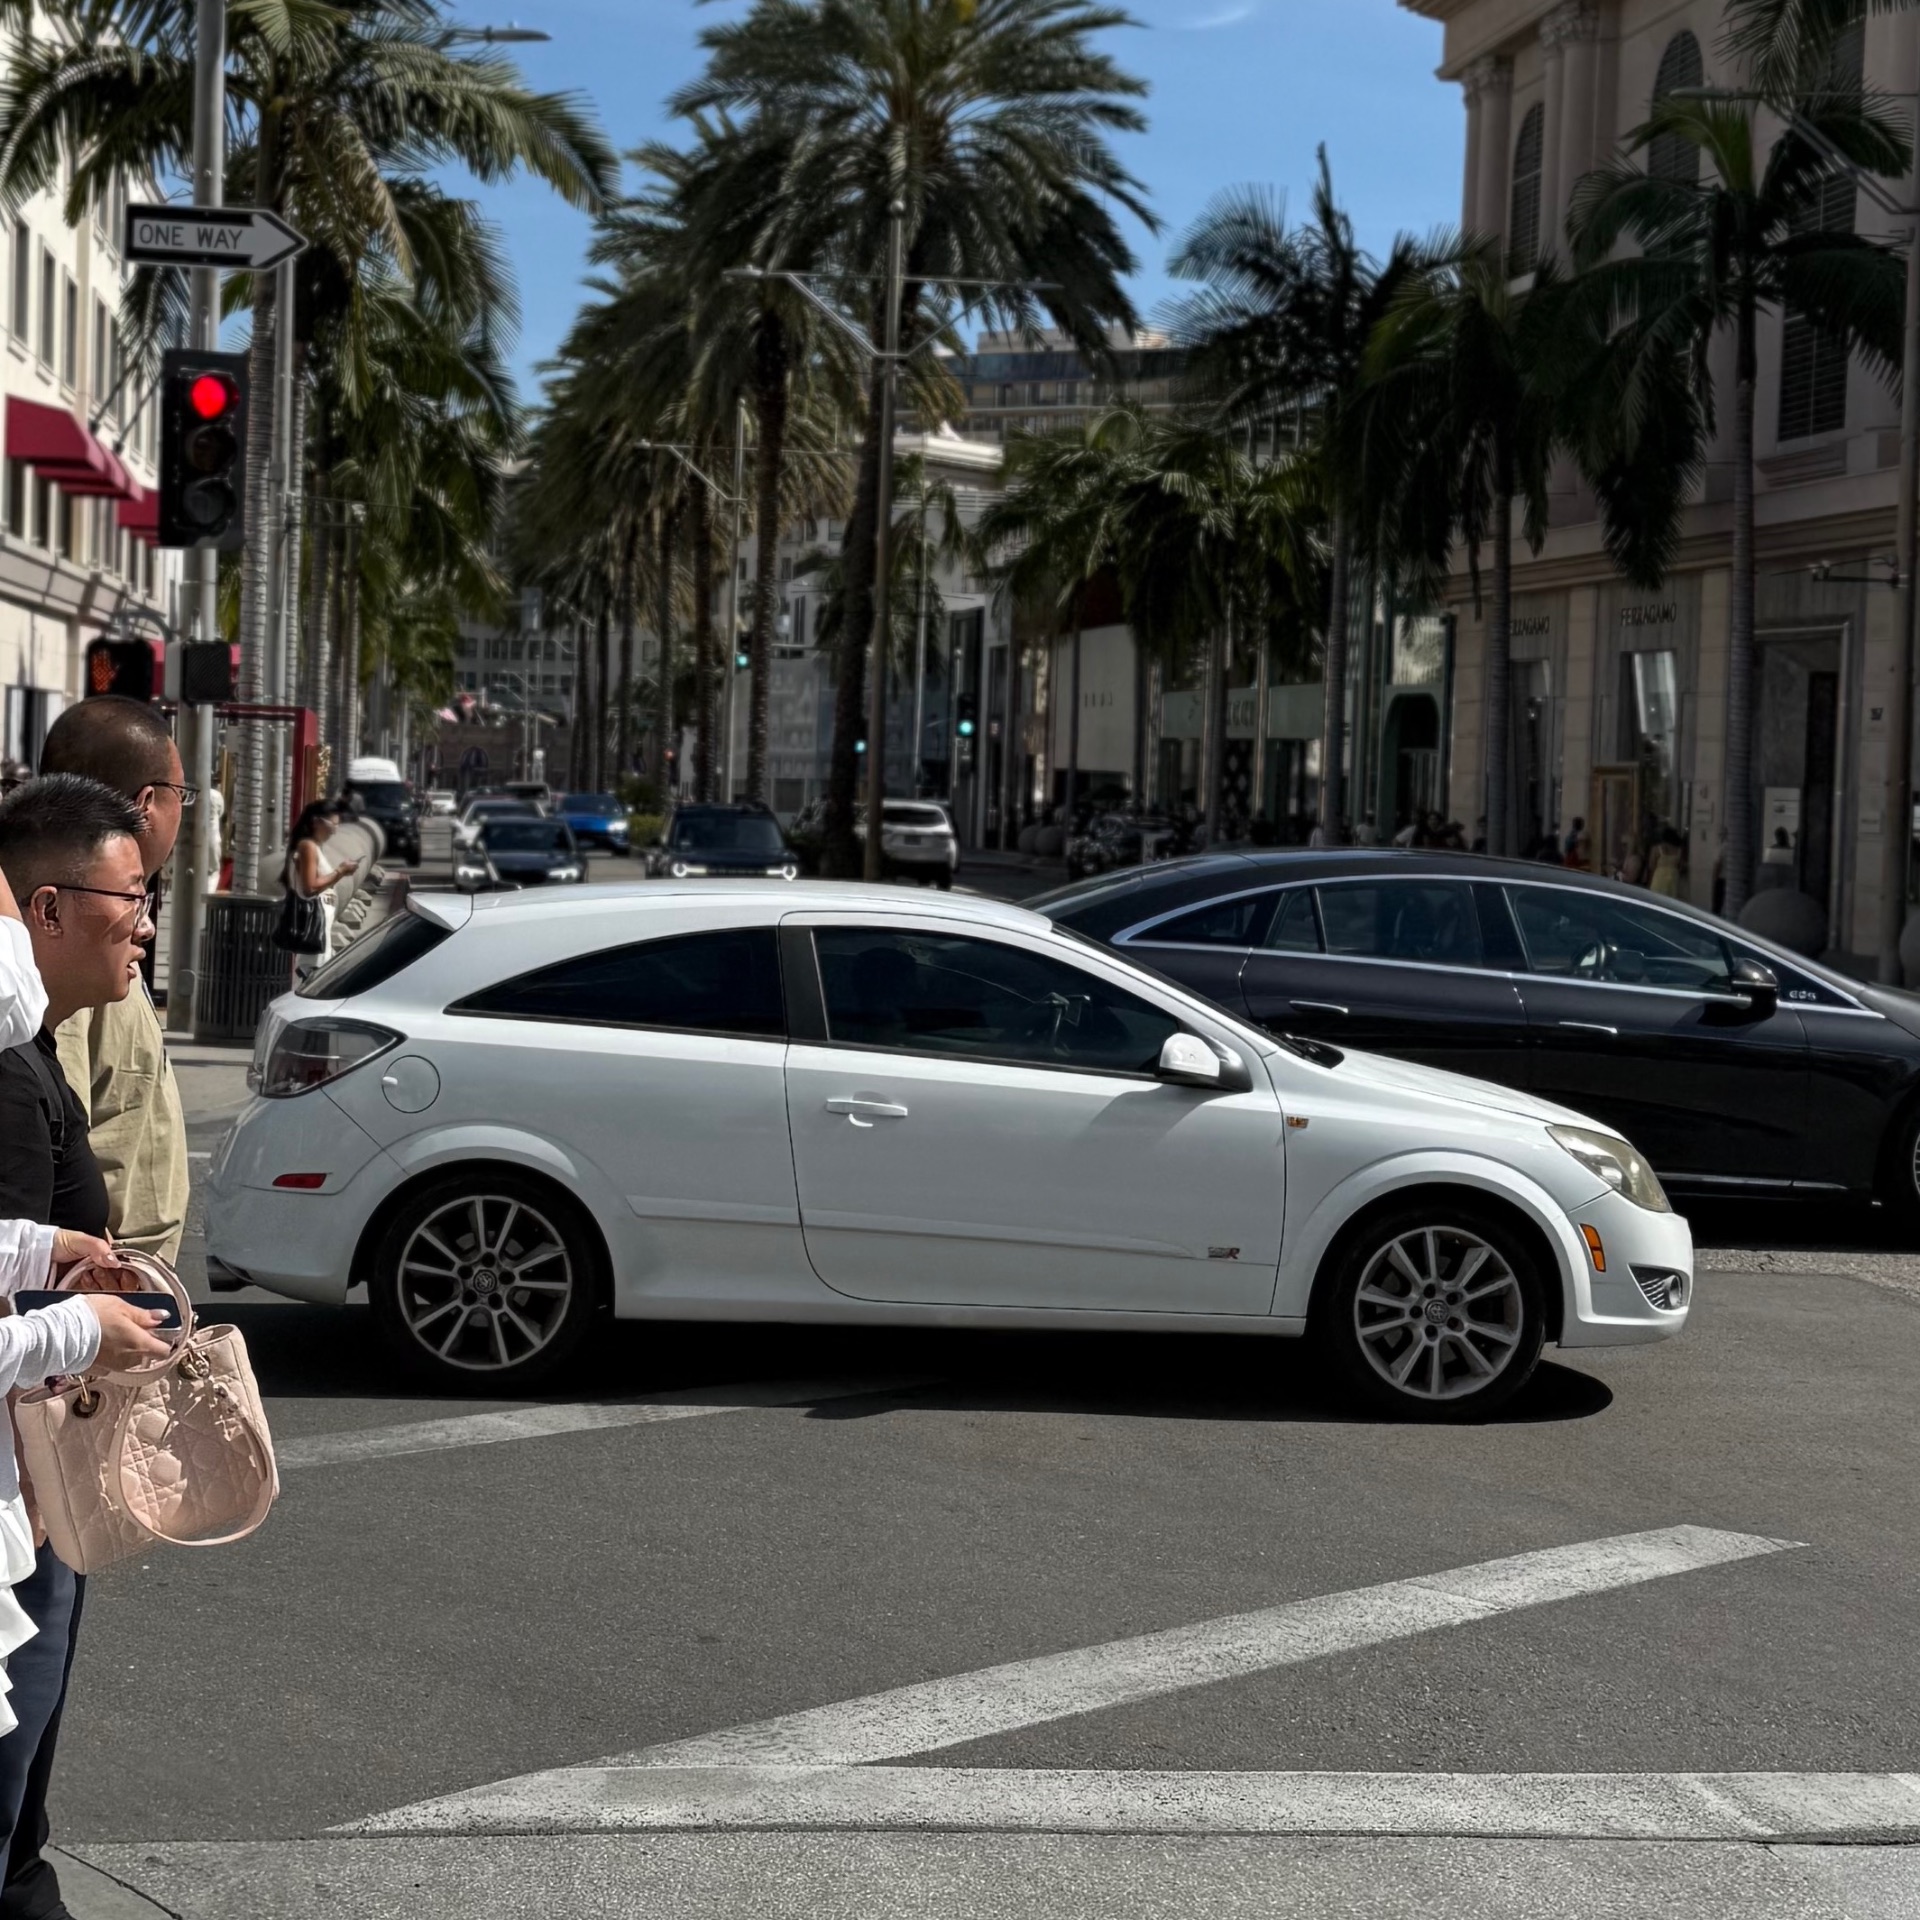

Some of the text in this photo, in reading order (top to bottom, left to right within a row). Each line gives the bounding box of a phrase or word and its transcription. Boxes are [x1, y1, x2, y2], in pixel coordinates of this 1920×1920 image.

[139, 223, 243, 250] ONE WAY
[1621, 603, 1677, 626] FERRAGAMO
